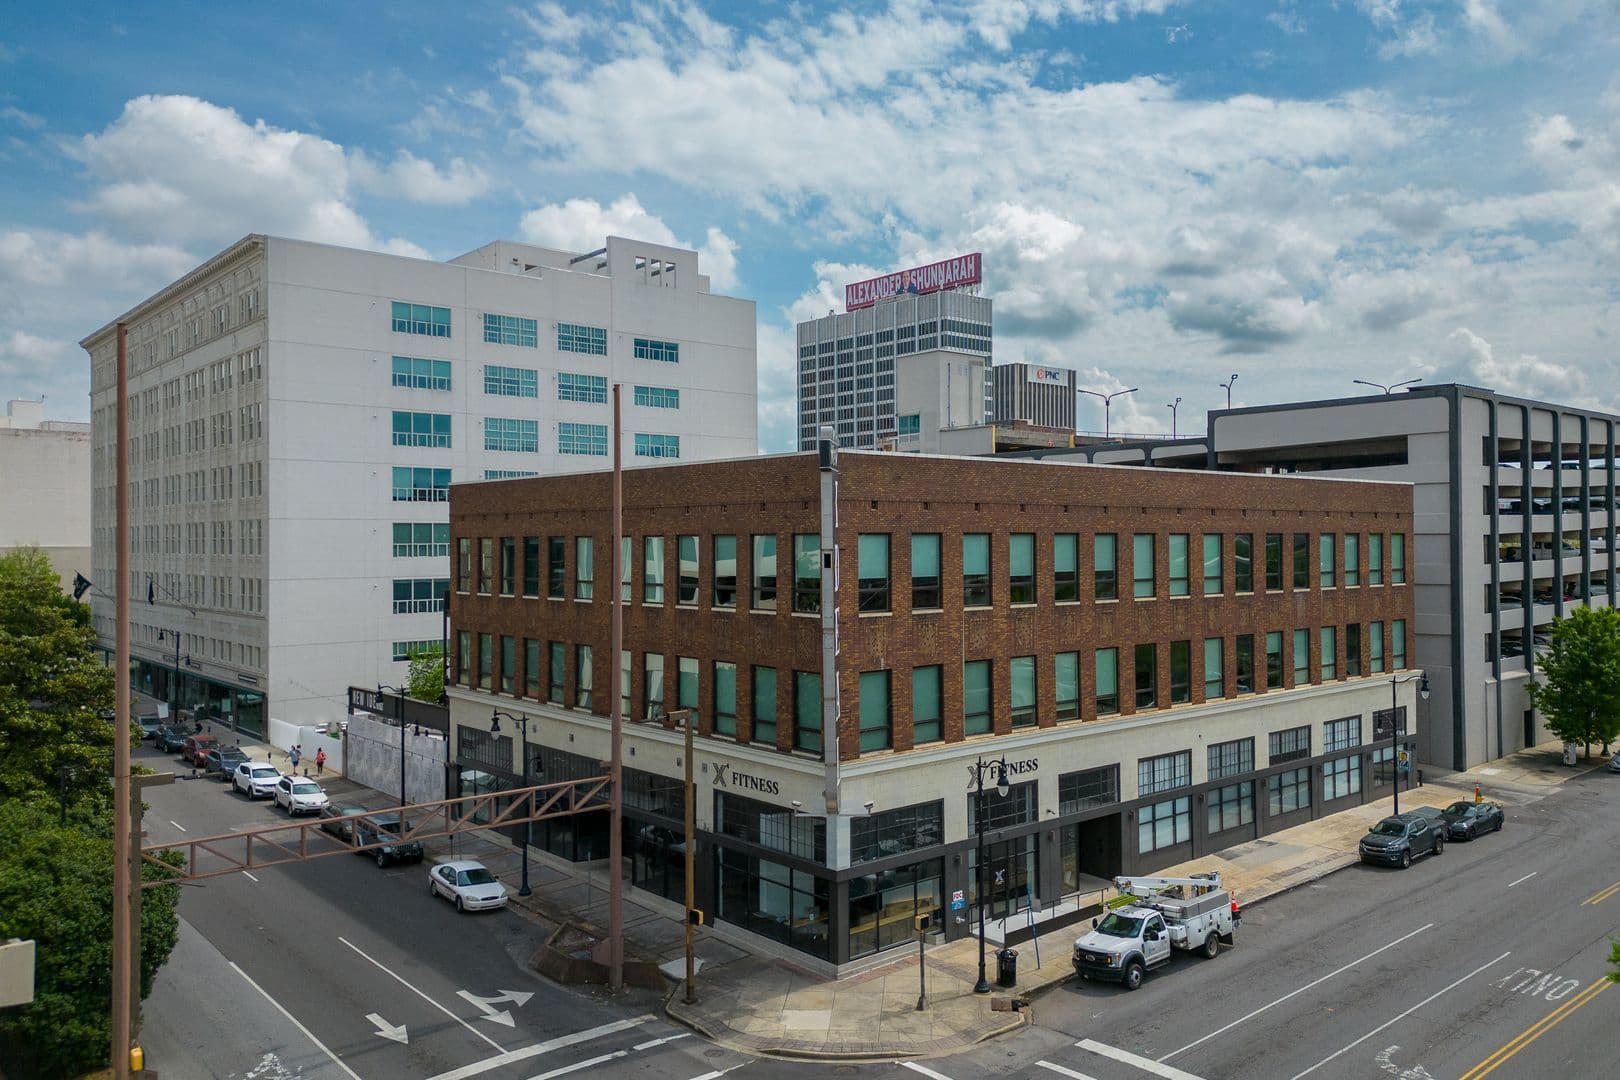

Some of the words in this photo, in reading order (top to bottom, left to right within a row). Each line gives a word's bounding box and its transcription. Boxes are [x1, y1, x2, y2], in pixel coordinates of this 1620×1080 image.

[847, 274, 901, 306] ALEXANDER
[911, 256, 975, 290] SHUNNARAH
[1045, 370, 1060, 381] PNC
[990, 758, 1038, 779] FINESS
[732, 772, 779, 795] FITNESS
